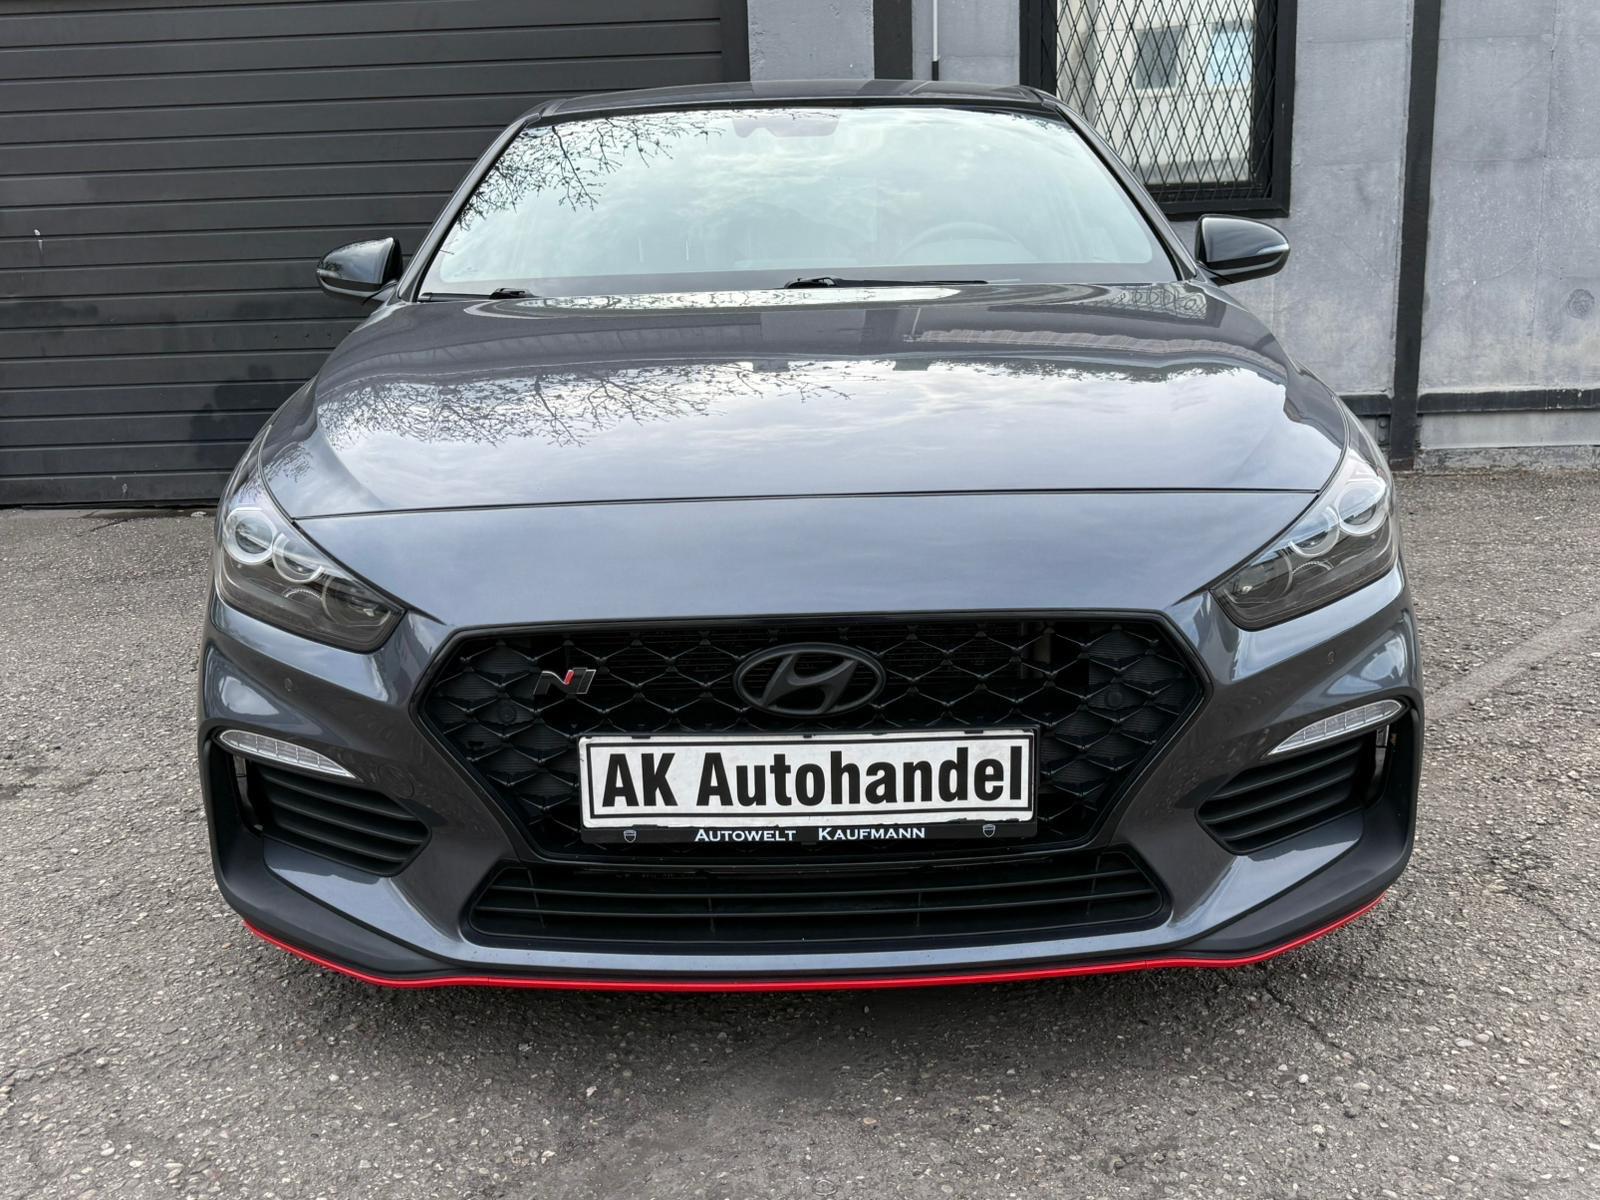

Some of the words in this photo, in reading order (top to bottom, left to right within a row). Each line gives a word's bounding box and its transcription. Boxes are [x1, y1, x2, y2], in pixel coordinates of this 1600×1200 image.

[602, 753, 678, 807] AK
[697, 747, 1023, 808] Autohandel
[694, 828, 797, 842] AUTOWELT
[817, 827, 926, 841] KAUFMANN
